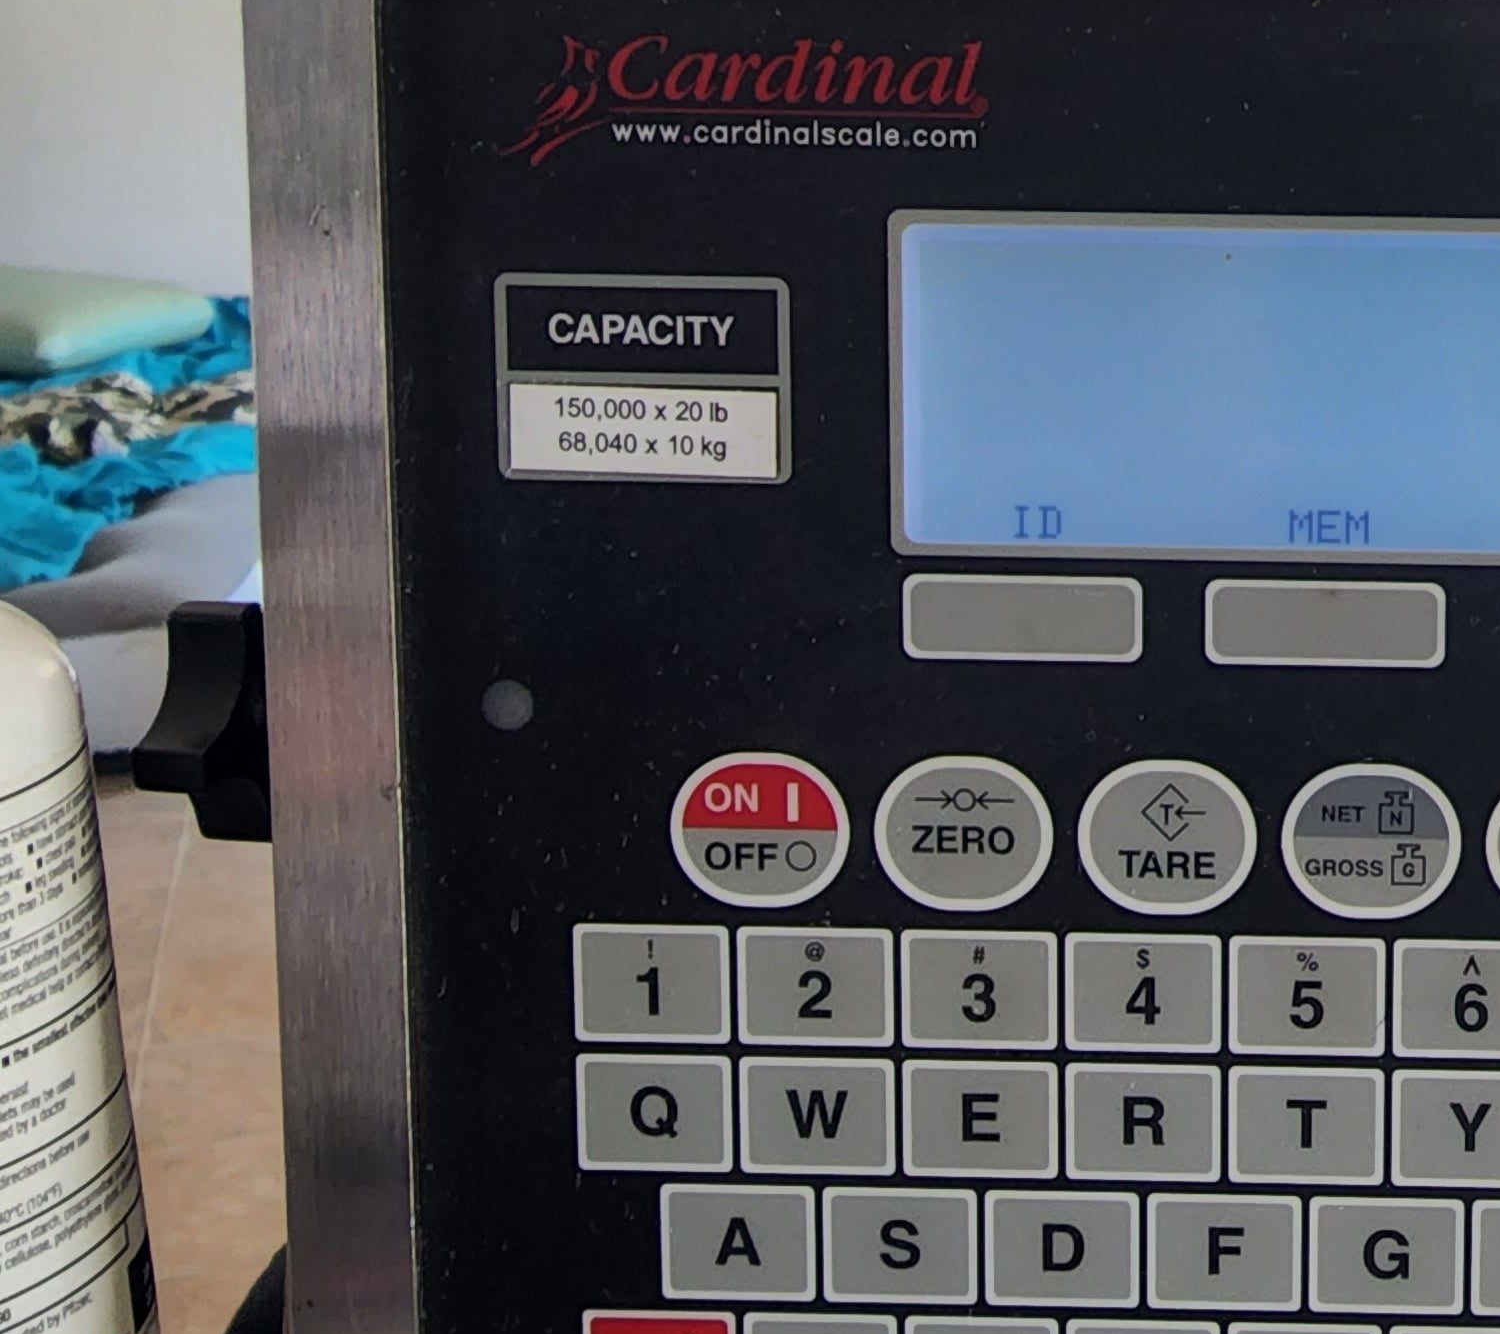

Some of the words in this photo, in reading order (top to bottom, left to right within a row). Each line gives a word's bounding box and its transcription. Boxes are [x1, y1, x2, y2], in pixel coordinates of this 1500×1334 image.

[607, 33, 984, 107] Cardinal
[611, 118, 978, 149] www.cardinalscale.com
[549, 313, 733, 345] CAPACITY
[554, 397, 647, 424] 150,000
[653, 406, 668, 422] x
[675, 400, 703, 422] 20
[709, 401, 729, 423] lb
[558, 431, 638, 458] 68,040
[645, 440, 659, 455] x
[668, 435, 695, 456] 10
[701, 436, 728, 463] kg
[1015, 506, 1061, 539] ID
[1289, 510, 1369, 544] MEM
[701, 780, 758, 812] ON
[1321, 805, 1365, 823] NET
[704, 842, 777, 871] OFF
[912, 826, 1014, 854] ZERO
[1118, 850, 1215, 879] TARE
[1304, 858, 1384, 878] GROSS
[637, 967, 659, 1015] 1
[799, 970, 832, 1018] 2
[962, 974, 996, 1022] 3
[1126, 977, 1160, 1025] 4
[1290, 980, 1324, 1029] 5
[1455, 984, 1488, 1032] 6
[631, 1086, 677, 1138] Q
[786, 1090, 848, 1138] W
[962, 1094, 1000, 1142] E
[1123, 1096, 1164, 1145] R
[1287, 1100, 1327, 1148] T
[1450, 1103, 1491, 1152] Y
[716, 1218, 761, 1266] A
[880, 1220, 920, 1269] S
[1042, 1224, 1084, 1271] D
[1209, 1227, 1244, 1275] F
[1364, 1230, 1409, 1279] G
